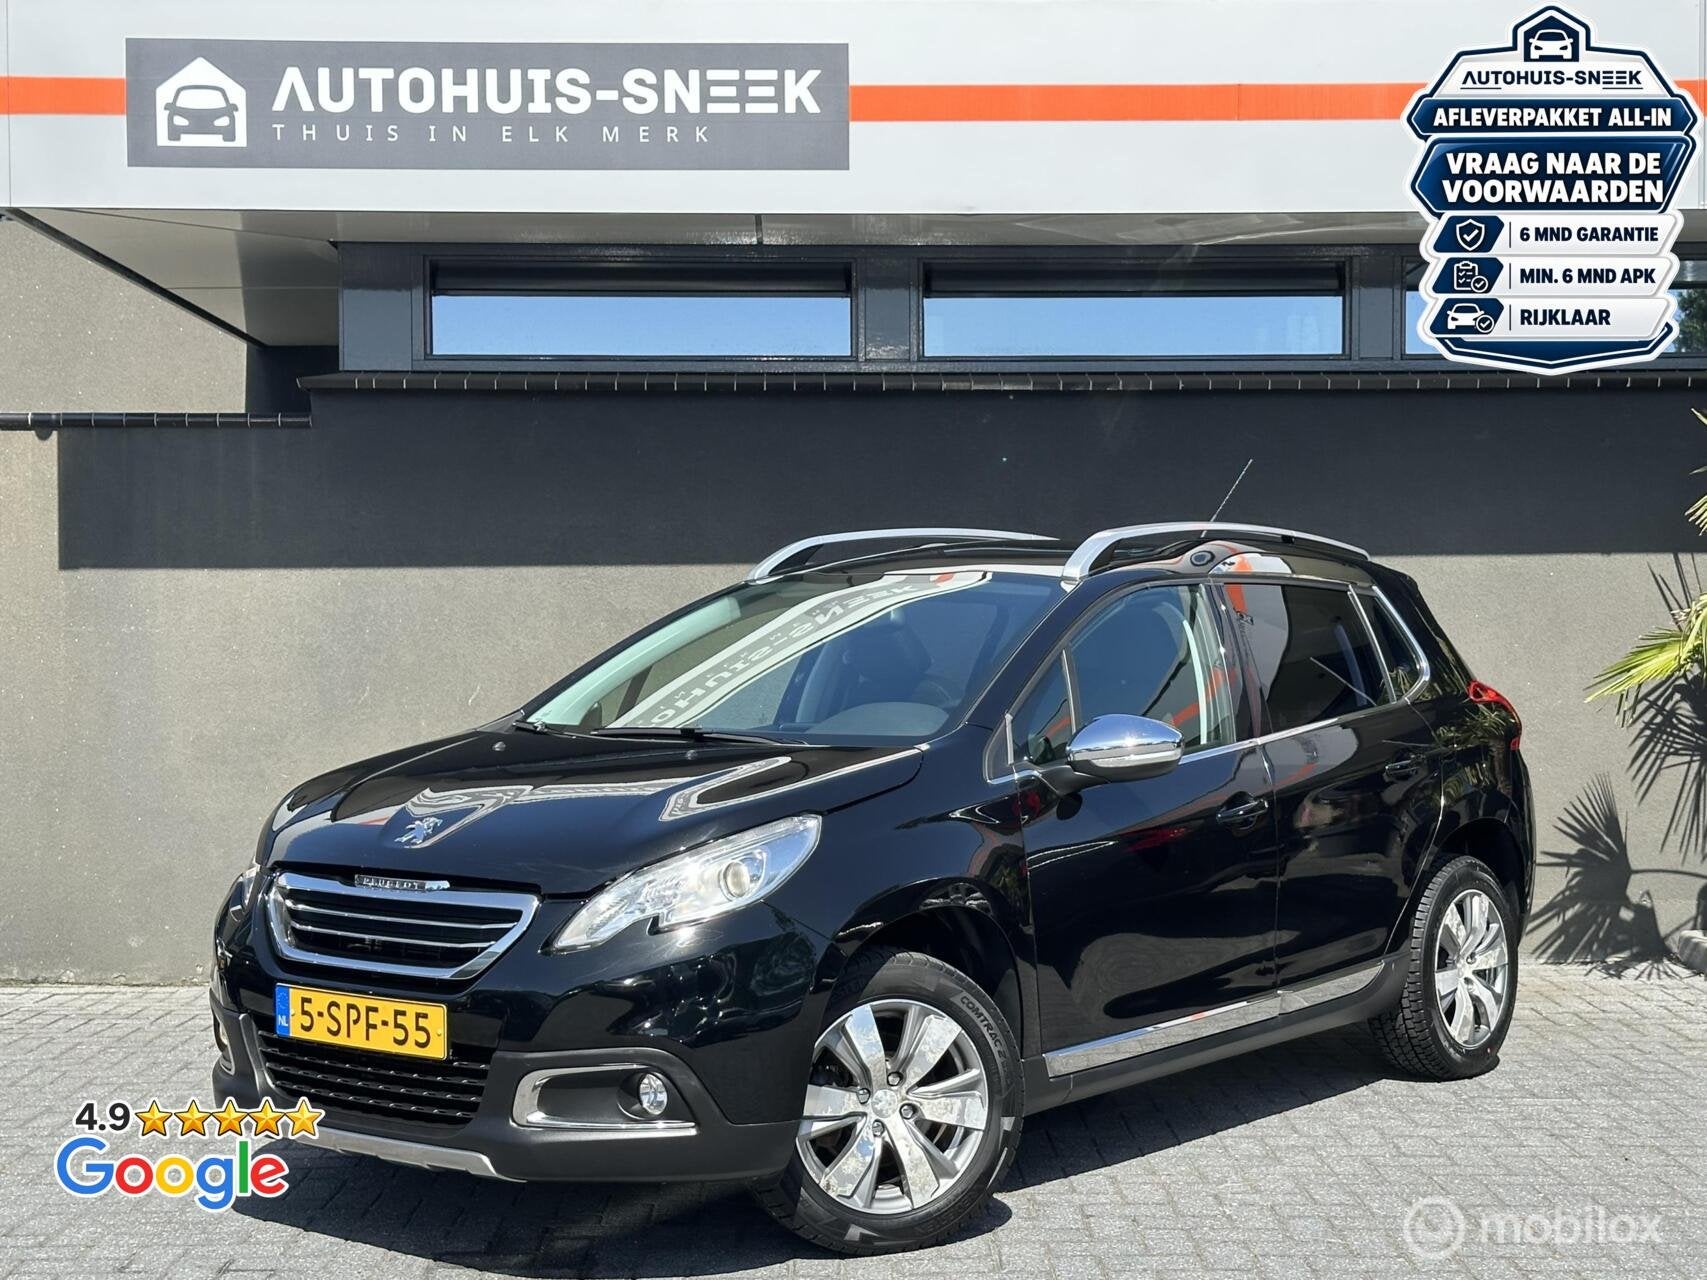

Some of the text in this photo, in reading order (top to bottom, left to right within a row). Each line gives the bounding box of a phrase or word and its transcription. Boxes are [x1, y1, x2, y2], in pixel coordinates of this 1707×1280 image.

[272, 66, 822, 115] AUTOHUIS-SNEEK
[272, 124, 710, 143] THUIS IN ELK MERK
[277, 1015, 288, 1026] NL
[300, 996, 431, 1049] 5-SPF-55
[960, 996, 1003, 1047] COMTRAC
